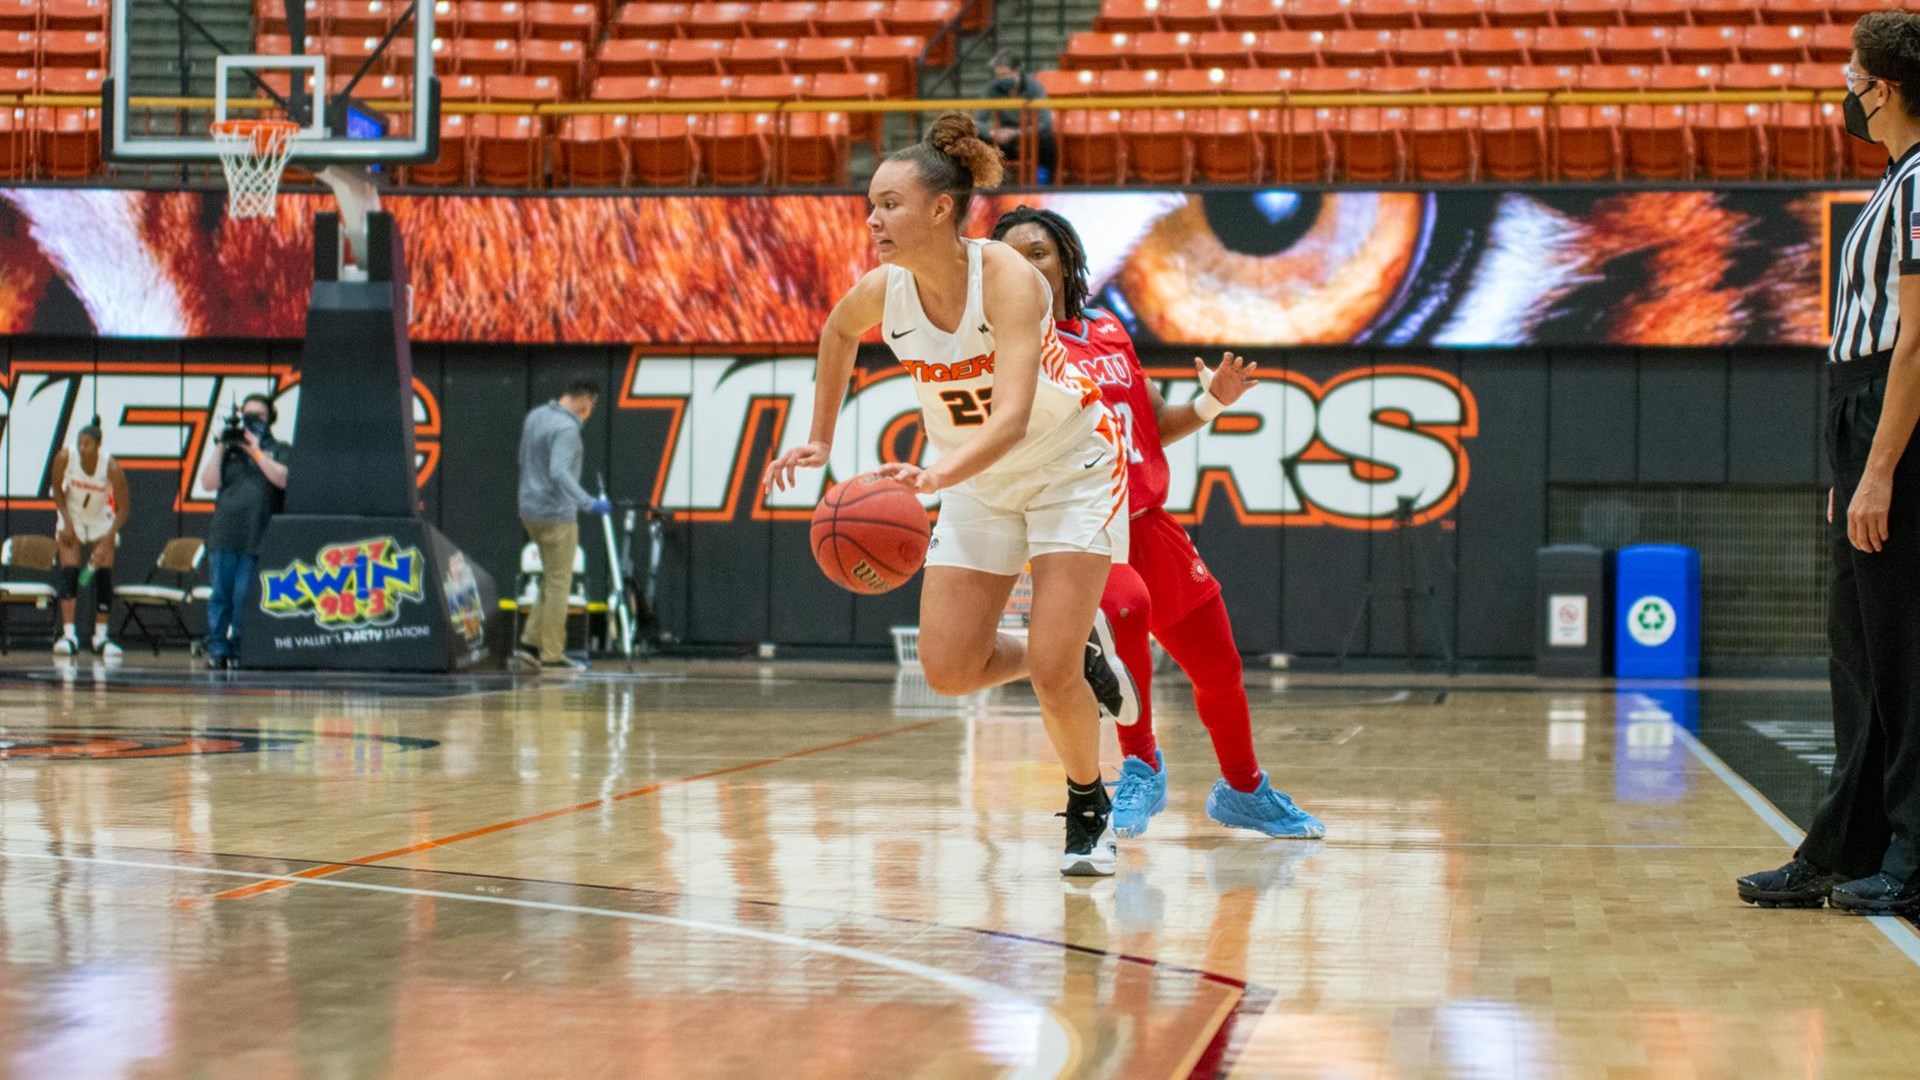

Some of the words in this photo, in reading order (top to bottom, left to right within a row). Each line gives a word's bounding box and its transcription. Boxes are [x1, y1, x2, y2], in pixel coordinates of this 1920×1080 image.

[900, 350, 995, 383] TIGER
[1078, 353, 1132, 388] MU
[0, 360, 441, 512] IFI
[619, 346, 1479, 530] TIRS
[274, 636, 293, 649] THE
[343, 629, 383, 643] PARTY
